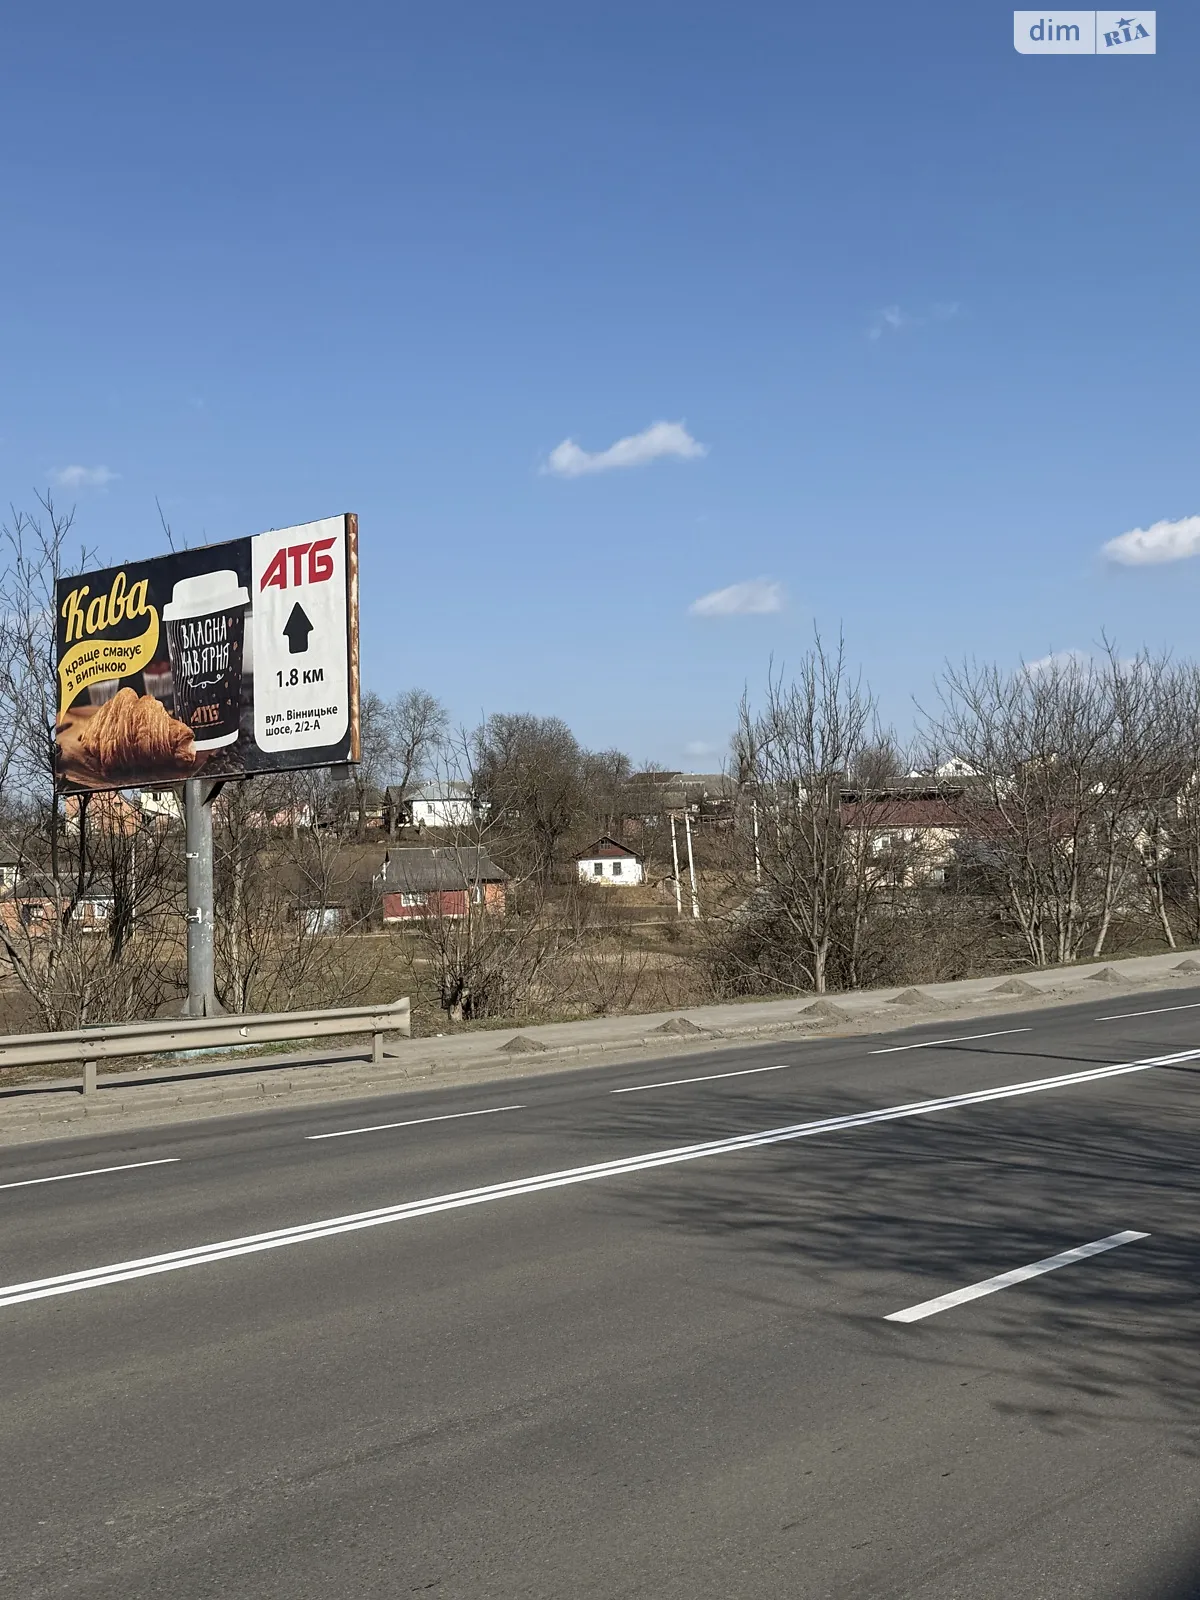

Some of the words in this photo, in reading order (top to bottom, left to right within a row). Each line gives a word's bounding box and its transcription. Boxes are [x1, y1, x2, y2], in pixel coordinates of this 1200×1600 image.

[260, 536, 338, 593] АТБ
[61, 571, 149, 643] Кава
[181, 615, 228, 650] ВЛАСНА
[65, 648, 101, 677] краще
[103, 644, 142, 660] смакує
[66, 681, 74, 692] з
[75, 661, 127, 685] випічкою
[276, 668, 299, 688] 1.8
[302, 668, 324, 684] км
[265, 713, 285, 726] вул.
[286, 705, 338, 721] Вінницьке
[265, 725, 293, 737] шосе,
[294, 719, 321, 733] 2/2-А
